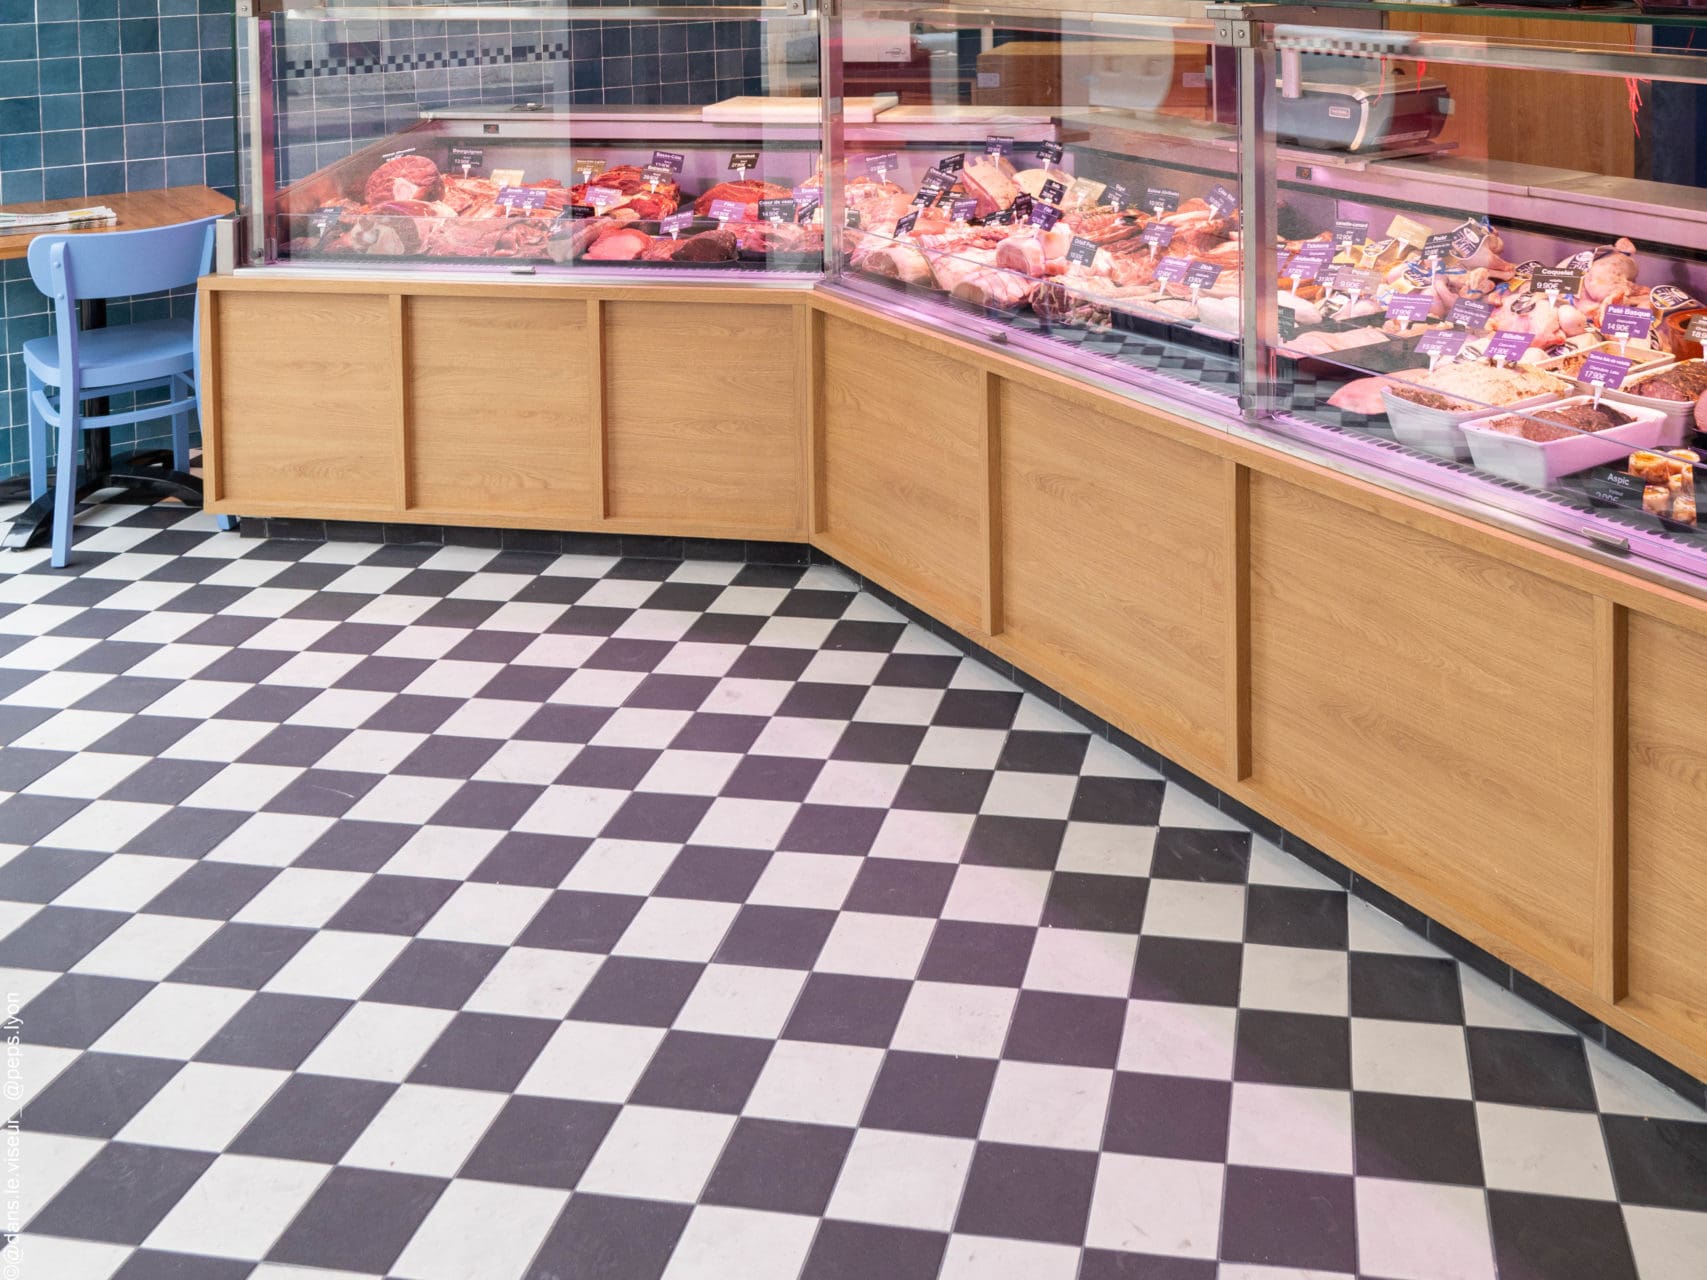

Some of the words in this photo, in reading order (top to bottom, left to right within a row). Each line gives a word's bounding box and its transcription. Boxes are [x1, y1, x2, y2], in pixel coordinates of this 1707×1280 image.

[1541, 268, 1574, 276] Coquelet
[1624, 307, 1652, 318] Basque
[1607, 472, 1630, 486] Aspic
